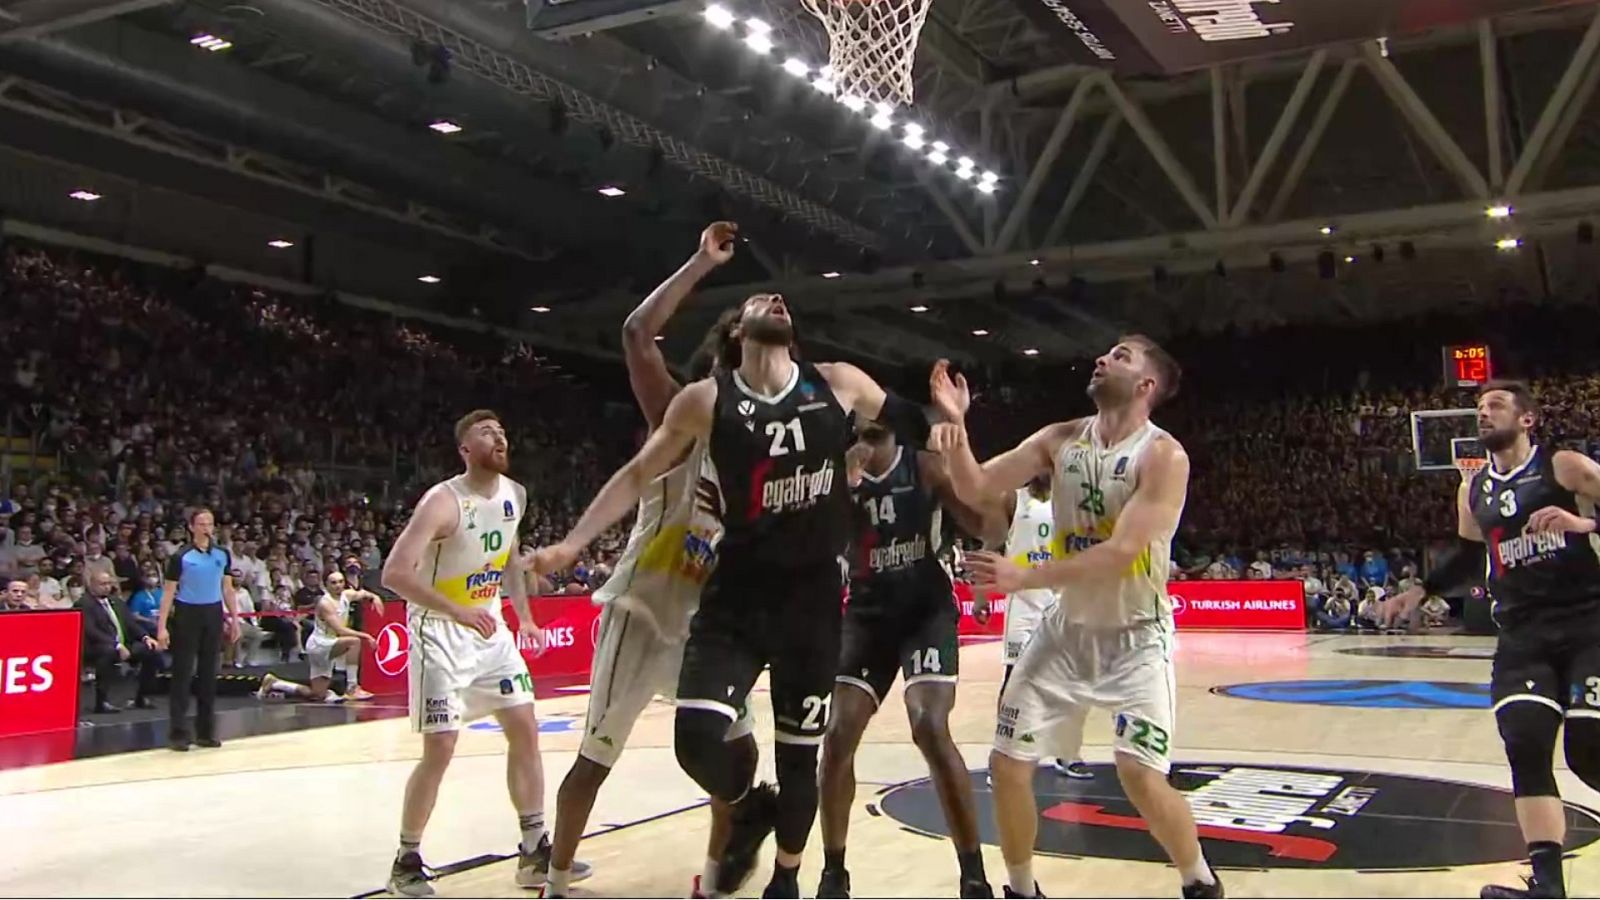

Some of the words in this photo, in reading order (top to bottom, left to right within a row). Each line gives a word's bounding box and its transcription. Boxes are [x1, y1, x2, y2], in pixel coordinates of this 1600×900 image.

[1460, 359, 1485, 379] 12
[765, 417, 806, 457] 21
[864, 494, 897, 525] 14
[1499, 489, 1518, 517] 3
[480, 530, 503, 553] 10
[1191, 600, 1241, 611] TURKISH
[1243, 600, 1297, 611] AIRLINES
[0, 654, 54, 695] ES
[911, 646, 942, 675] 14
[801, 691, 833, 730] 21
[1130, 718, 1169, 756] 23
